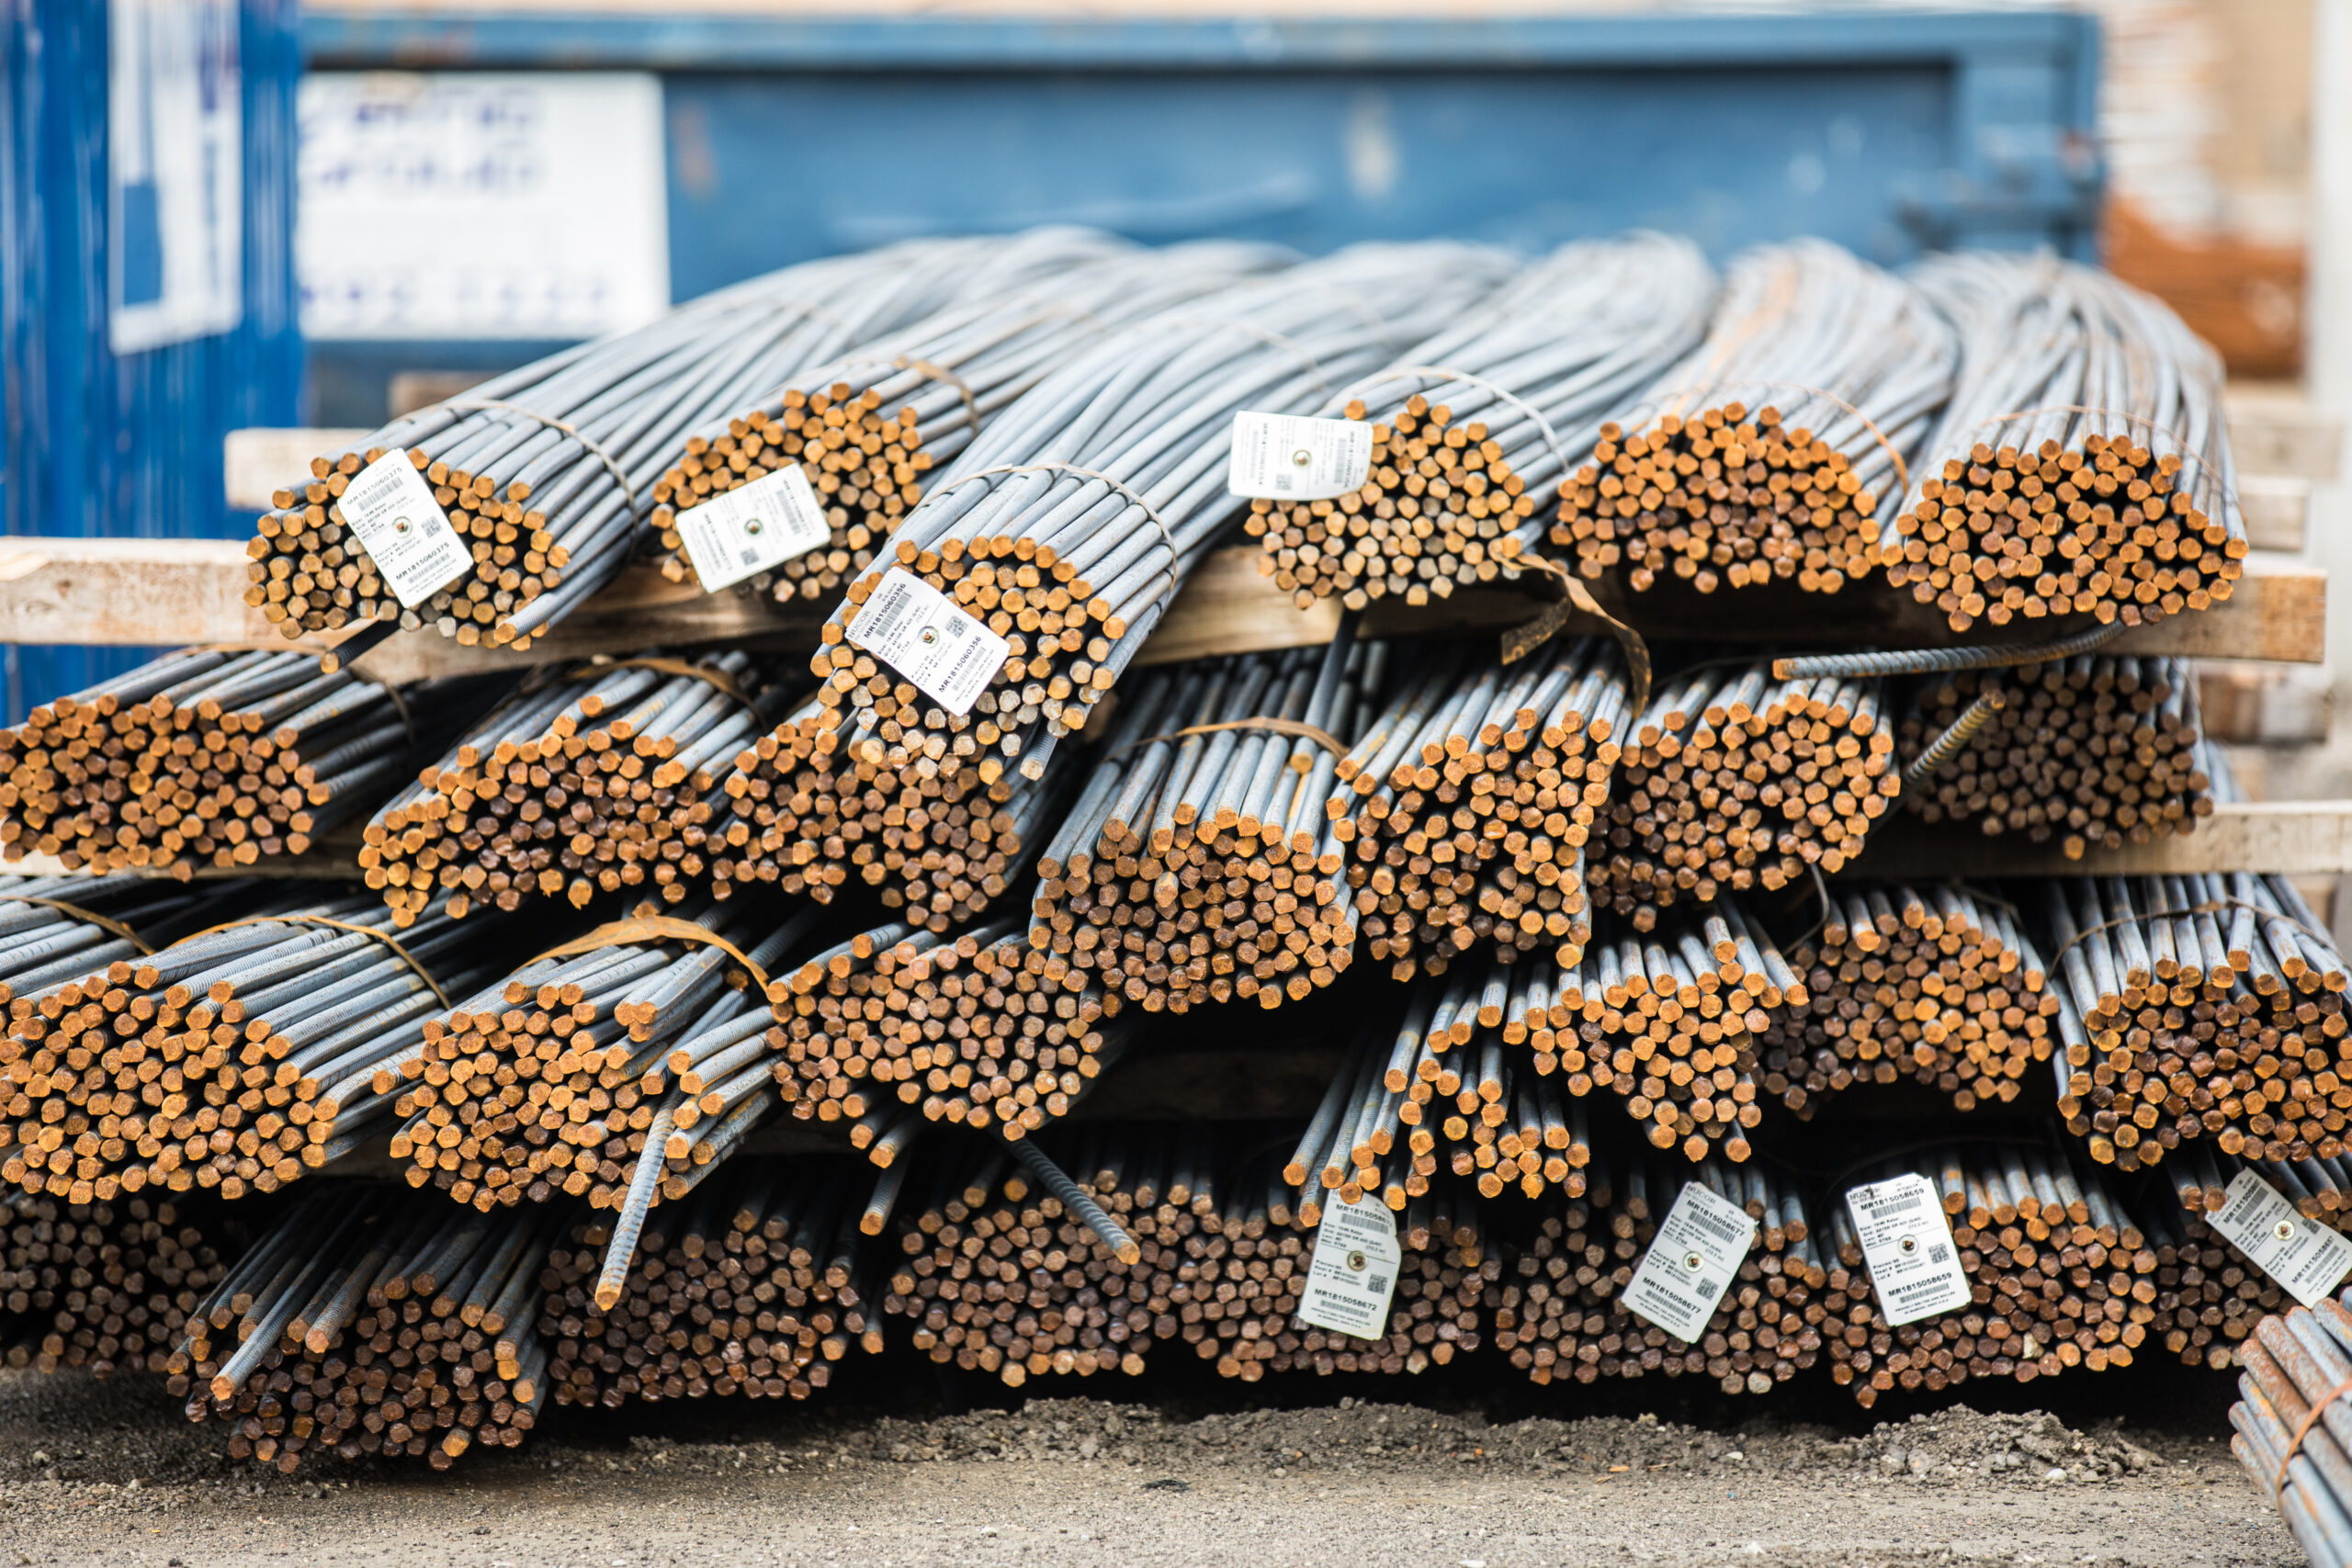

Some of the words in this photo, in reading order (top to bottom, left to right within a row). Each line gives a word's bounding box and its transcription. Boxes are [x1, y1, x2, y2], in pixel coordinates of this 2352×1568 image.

[847, 608, 871, 637] NUCOR
[862, 581, 907, 638] MR1815060356
[936, 635, 982, 693] MR1815060356
[1860, 1187, 1925, 1211] MR1815058659
[1686, 1198, 1745, 1237] MR1815058677
[1314, 1288, 1377, 1311] MR1815058672
[1642, 1275, 1702, 1315] MR1815058677
[1887, 1271, 1952, 1296] MR1815058659
